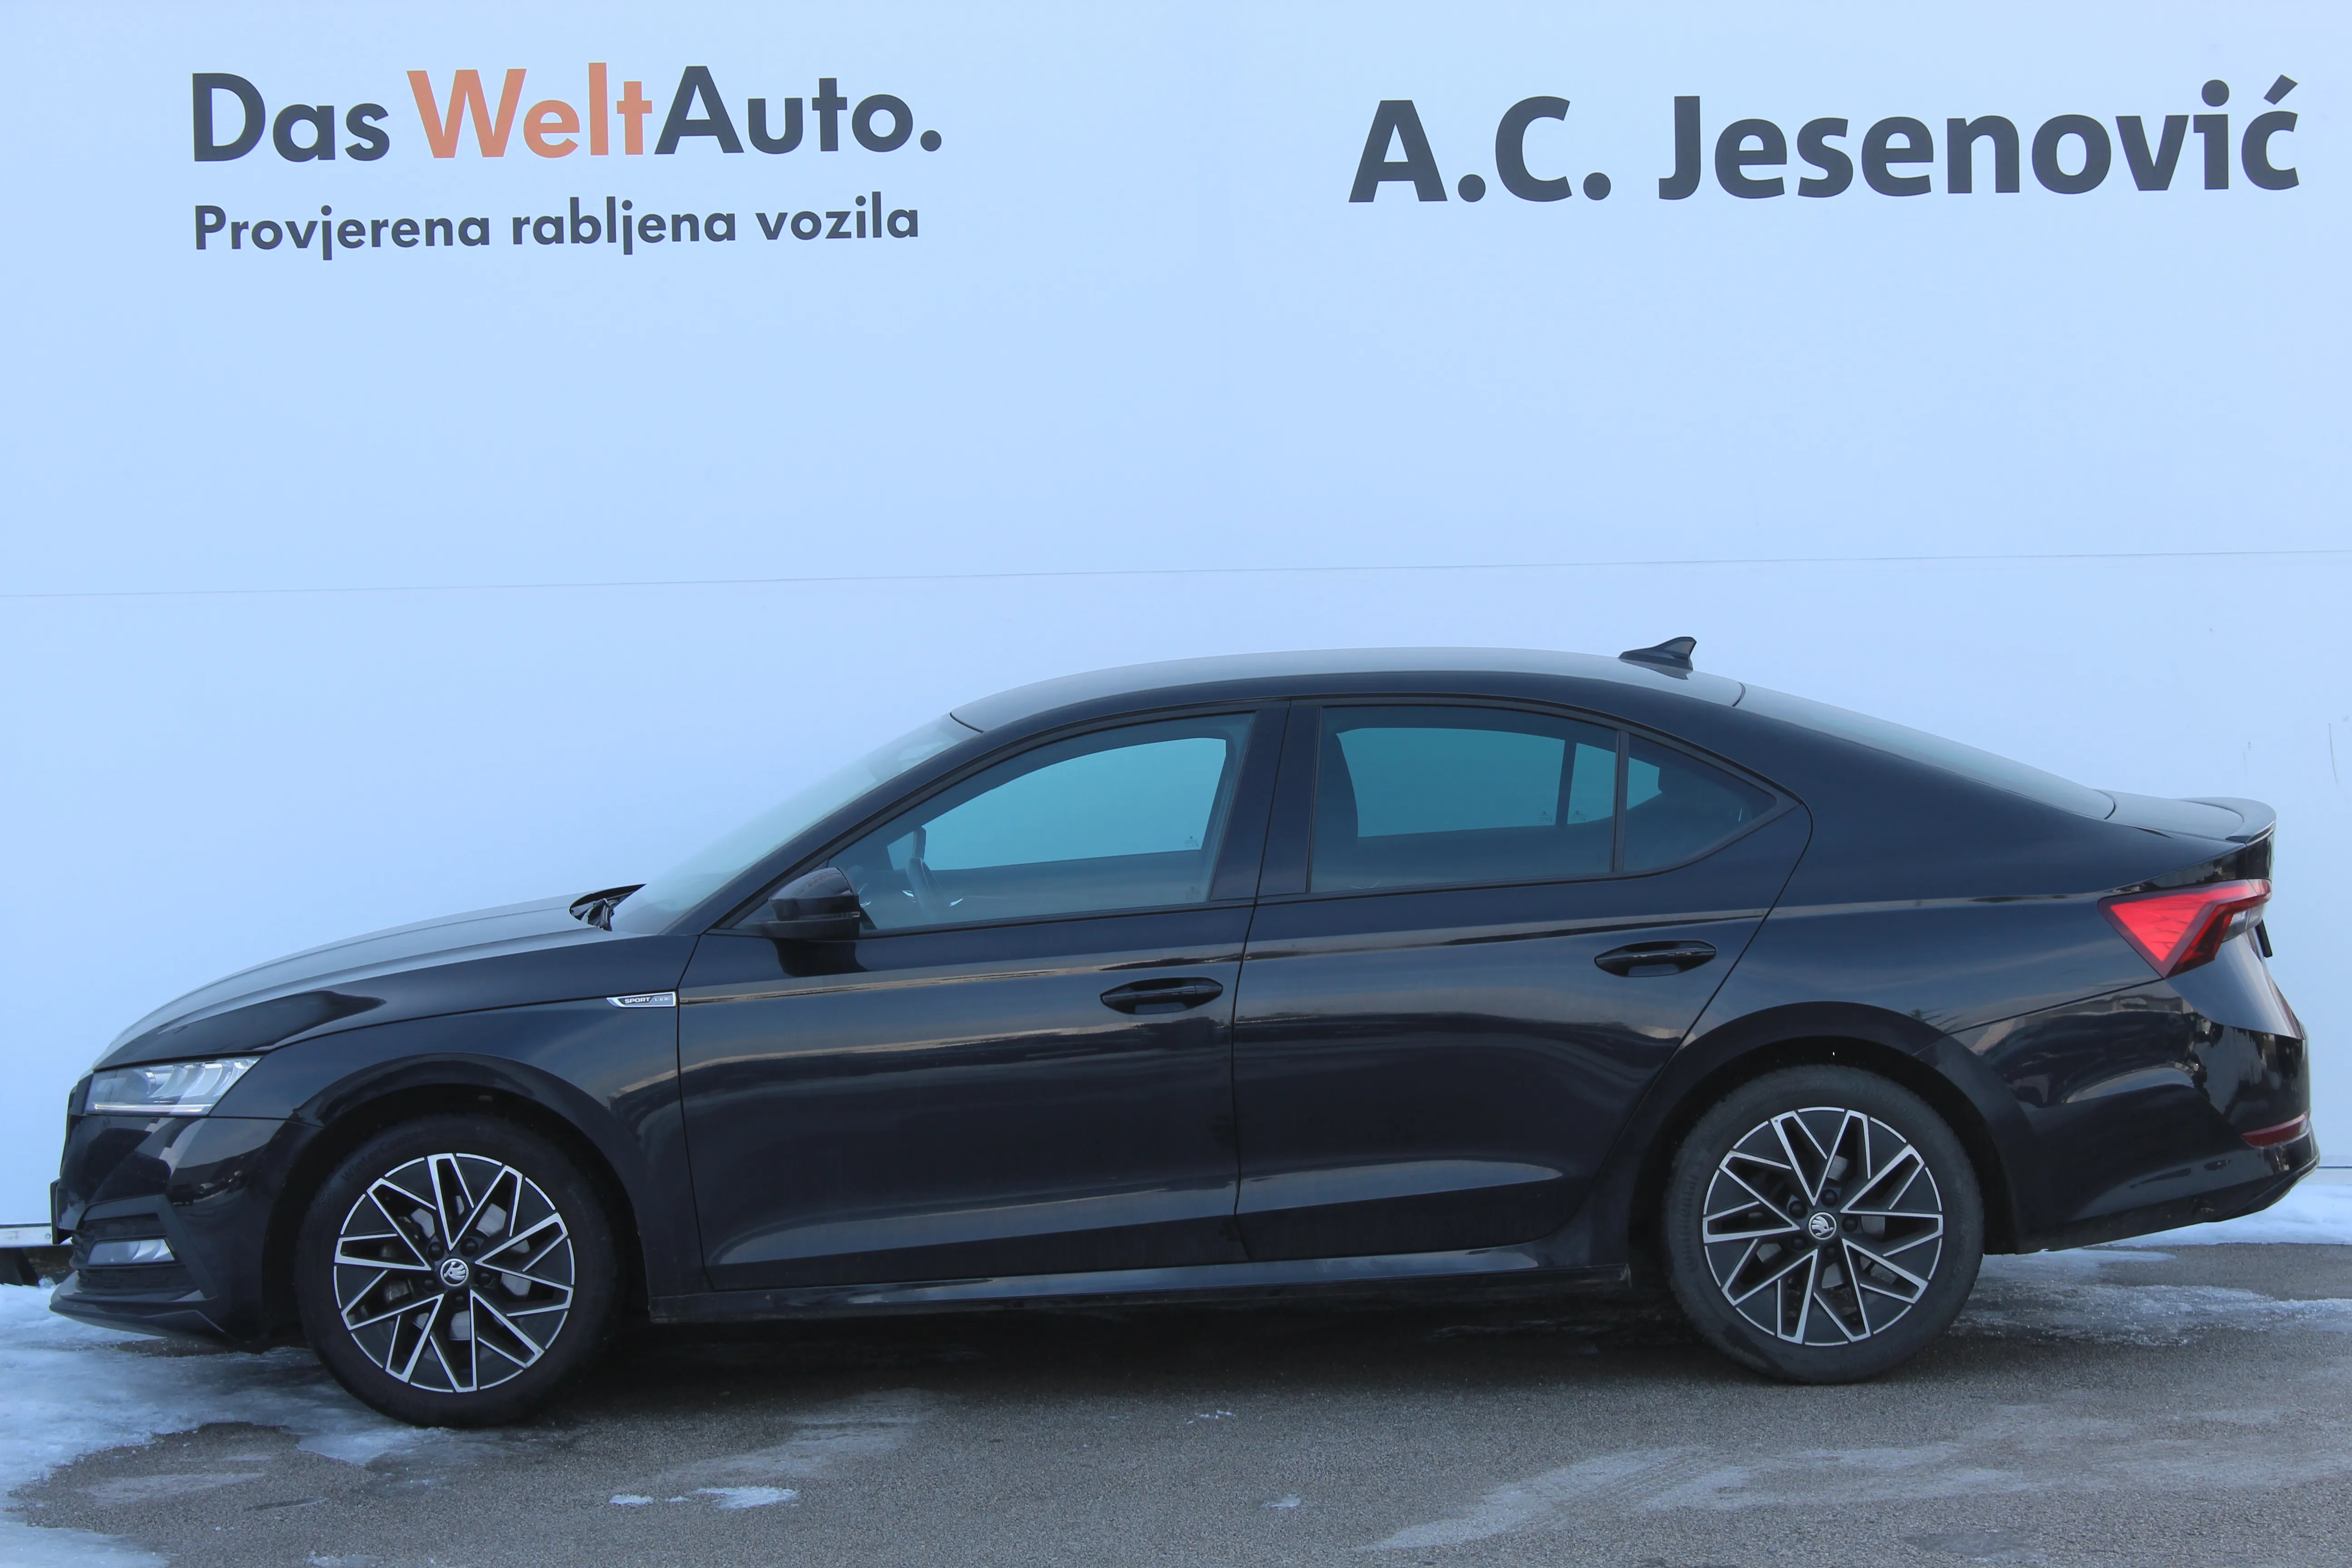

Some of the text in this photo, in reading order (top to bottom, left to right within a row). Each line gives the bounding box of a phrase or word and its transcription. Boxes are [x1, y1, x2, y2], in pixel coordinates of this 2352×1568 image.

[193, 62, 942, 162] Das WeltAuto.
[1349, 75, 2299, 203] A.C. Jesenović
[196, 191, 919, 261] Provjerena rabljena vozila
